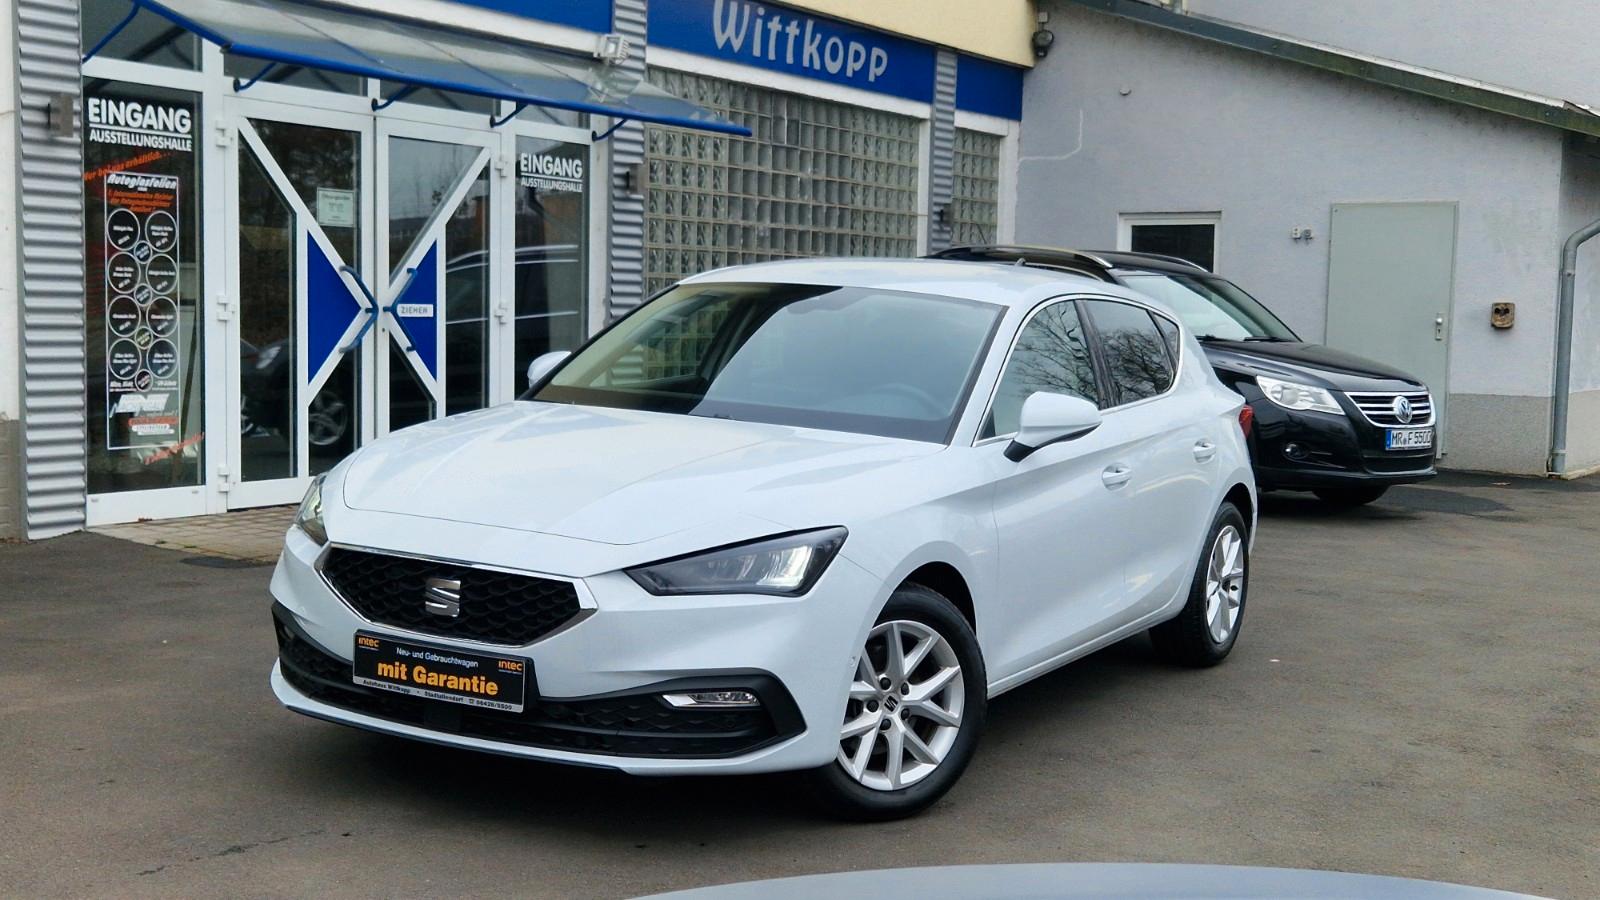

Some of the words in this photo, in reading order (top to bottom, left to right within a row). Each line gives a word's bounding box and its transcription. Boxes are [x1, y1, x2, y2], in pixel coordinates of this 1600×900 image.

[713, 0, 888, 82] Wittkopp
[88, 97, 192, 134] EINGANG
[89, 129, 192, 152] AUSSTELLUNGSHALLE
[520, 152, 583, 178] EINGANG
[107, 173, 177, 189] Autoglasfolien
[521, 177, 583, 193] AUSSTELLUNGSHALLE
[401, 306, 428, 314] ZIEHEN
[1392, 431, 1403, 446] MR
[1407, 431, 1414, 445] F
[358, 636, 379, 648] intec
[396, 647, 411, 658] Neu-
[413, 651, 424, 660] und
[424, 652, 479, 669] Gebrauchtwagen
[498, 660, 523, 672] intec
[363, 679, 386, 689] Autohaus
[387, 683, 411, 695] Wittkopp
[377, 662, 408, 681] mit
[412, 665, 499, 696] Garantie
